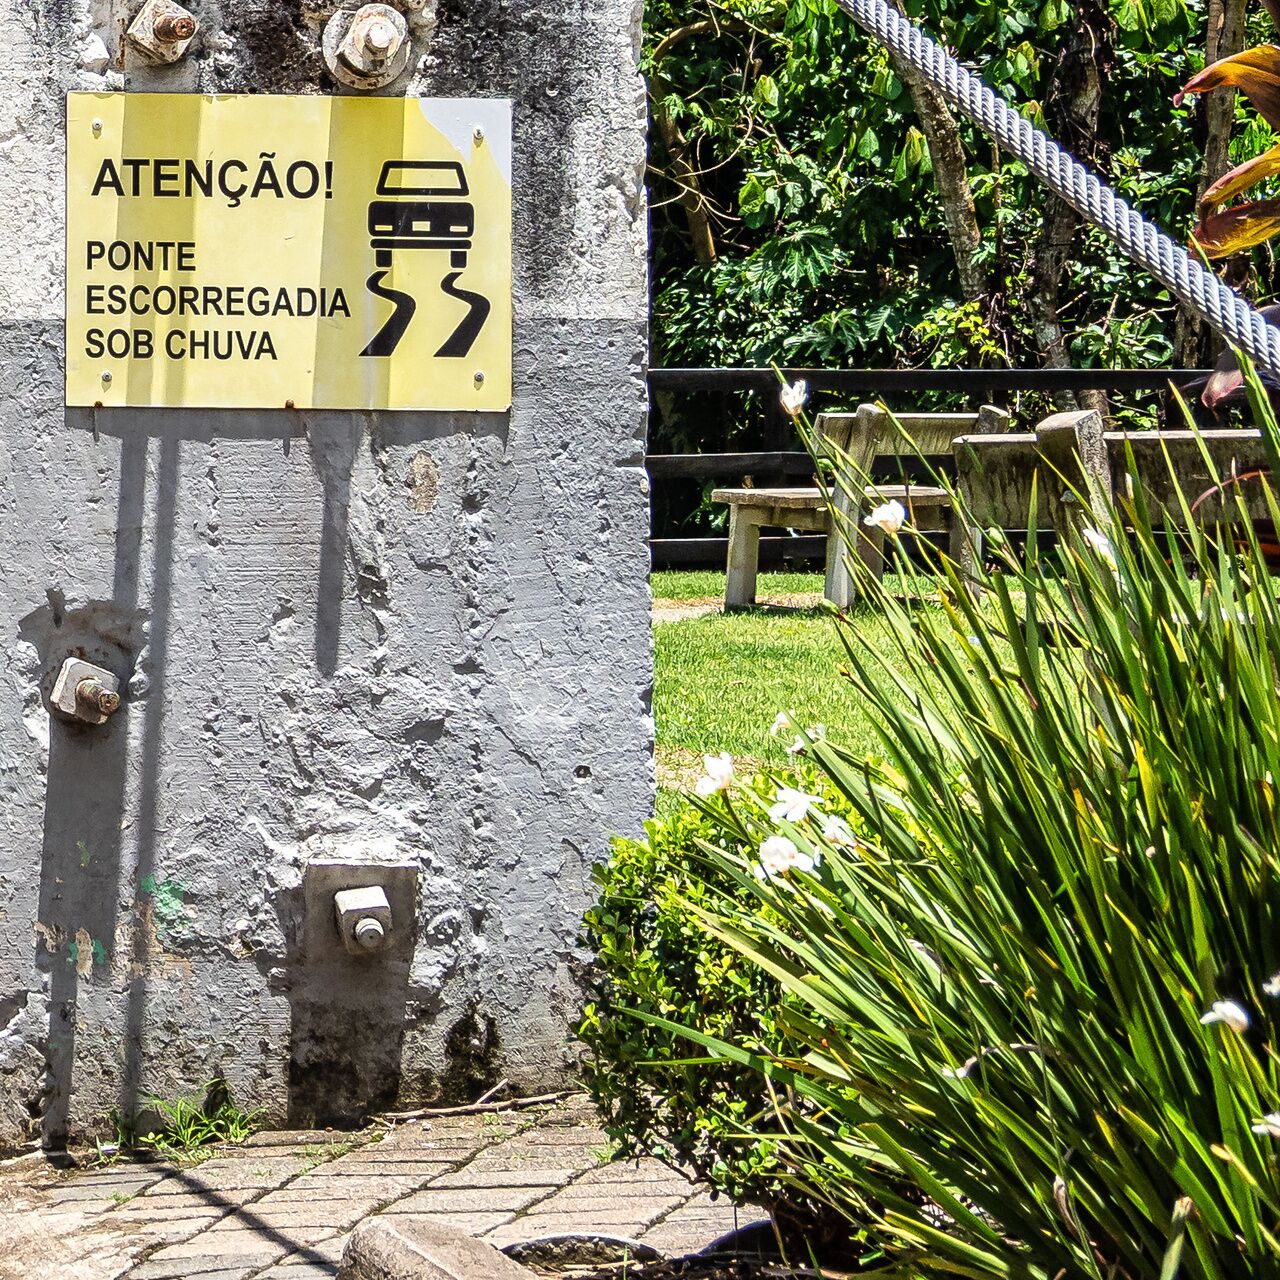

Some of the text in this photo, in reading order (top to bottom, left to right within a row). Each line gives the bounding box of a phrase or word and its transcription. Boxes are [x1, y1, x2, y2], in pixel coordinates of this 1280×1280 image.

[91, 152, 333, 208] ATENÇÃO!
[87, 240, 196, 271] PONTE
[86, 284, 351, 318] ESCORREGADIA
[85, 328, 278, 360] SOB CHUVA
